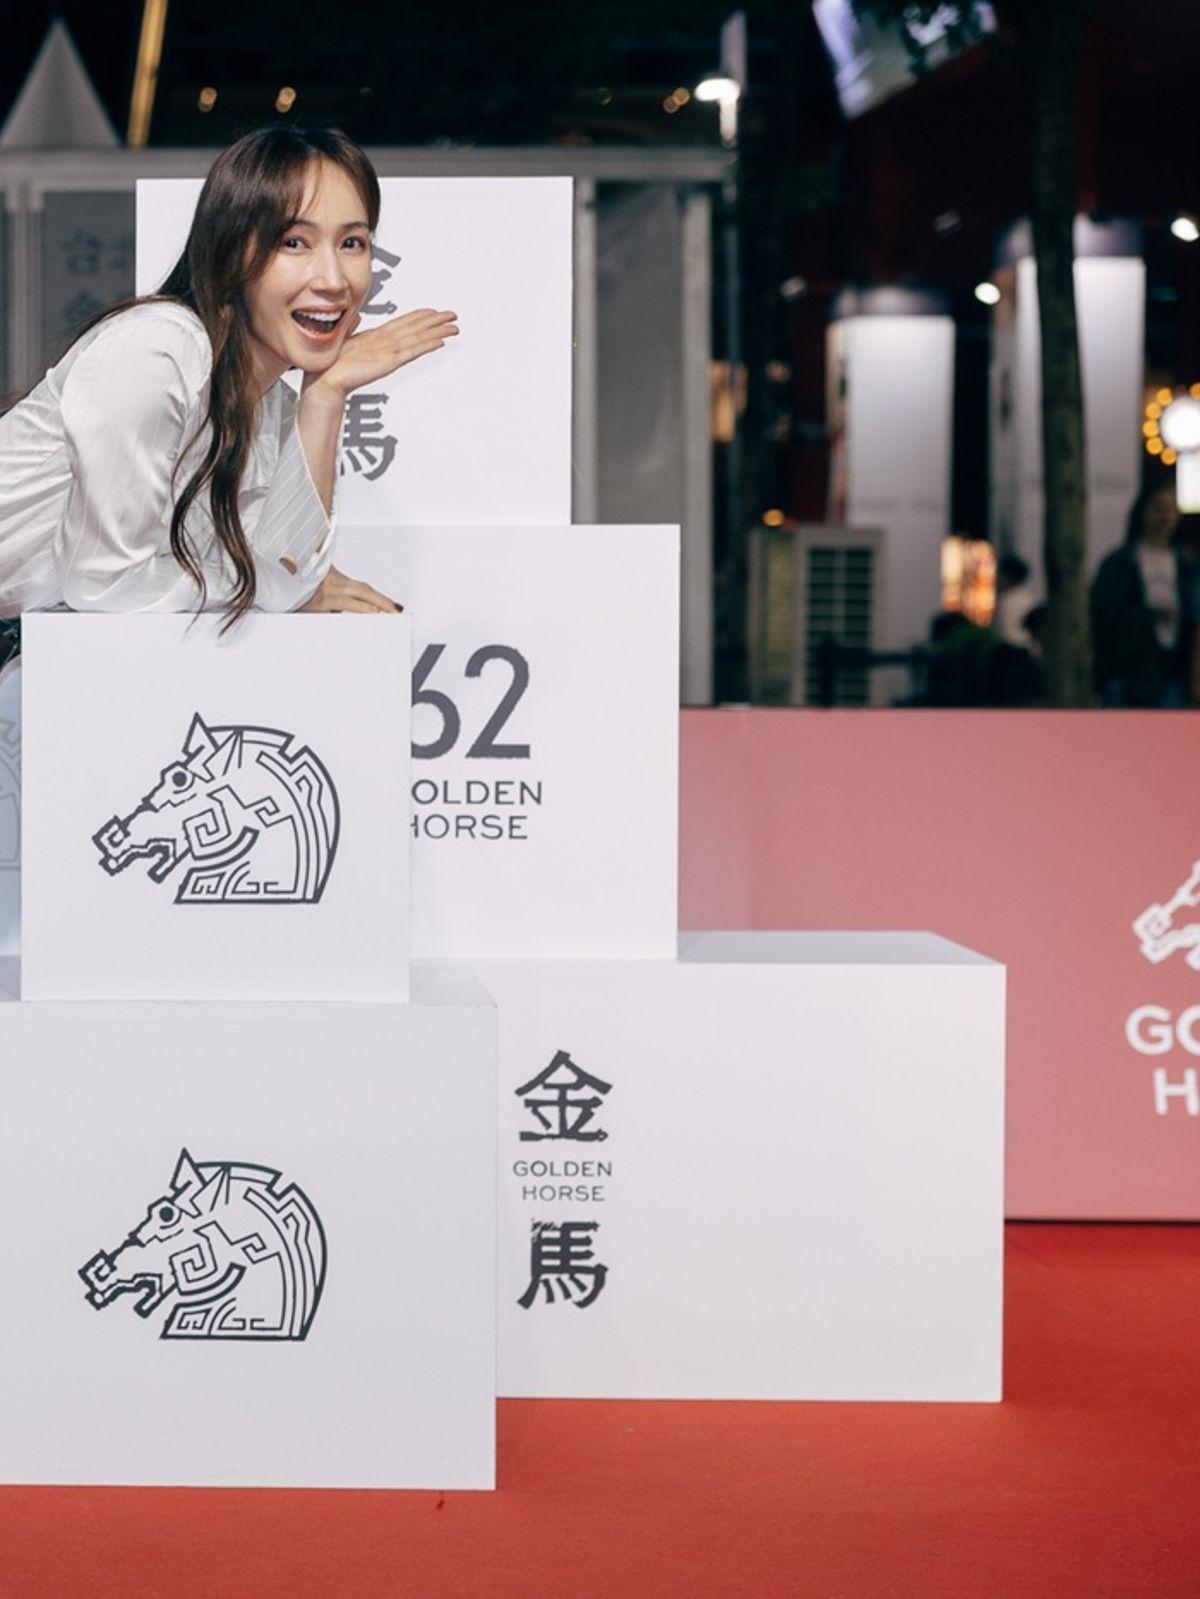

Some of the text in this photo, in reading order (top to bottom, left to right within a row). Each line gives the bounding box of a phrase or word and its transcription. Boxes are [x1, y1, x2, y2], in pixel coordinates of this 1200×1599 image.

[411, 643, 530, 759] 62
[411, 779, 542, 805] OLDEN
[514, 1049, 613, 1142] 金
[513, 1160, 612, 1177] GOLDEN
[522, 1185, 605, 1201] HORSE
[516, 1218, 609, 1310] 馬
